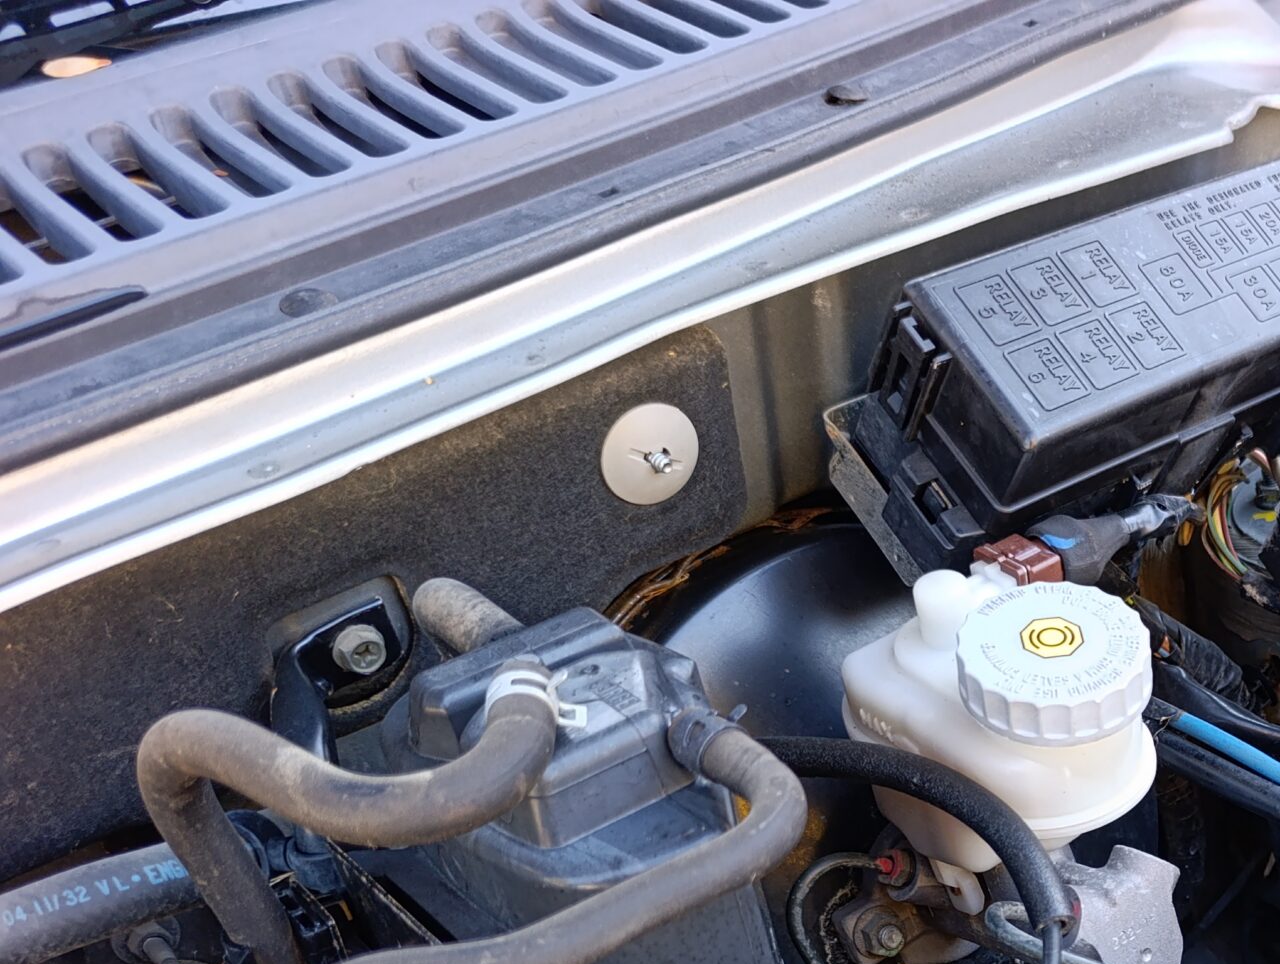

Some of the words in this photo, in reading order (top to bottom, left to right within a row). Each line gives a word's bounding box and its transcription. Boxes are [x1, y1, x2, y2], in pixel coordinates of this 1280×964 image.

[1156, 210, 1177, 221] USE
[1182, 201, 1201, 212] THE
[1206, 180, 1262, 204] DESIGNATED
[1163, 212, 1202, 231] RELAYS
[1181, 235, 1207, 262] DIODE
[1081, 270, 1097, 280] 1
[1085, 248, 1130, 291] RELAY
[1030, 288, 1048, 300] 3
[1036, 264, 1082, 308] RELAY
[978, 308, 998, 319] 5
[985, 283, 1033, 328] RELAY
[1127, 331, 1145, 344] 2
[1133, 308, 1178, 352] RELAY
[1080, 352, 1097, 364] 4
[1085, 326, 1130, 371] RELAY
[1028, 371, 1046, 384] 6
[1034, 346, 1081, 392] RELAY
